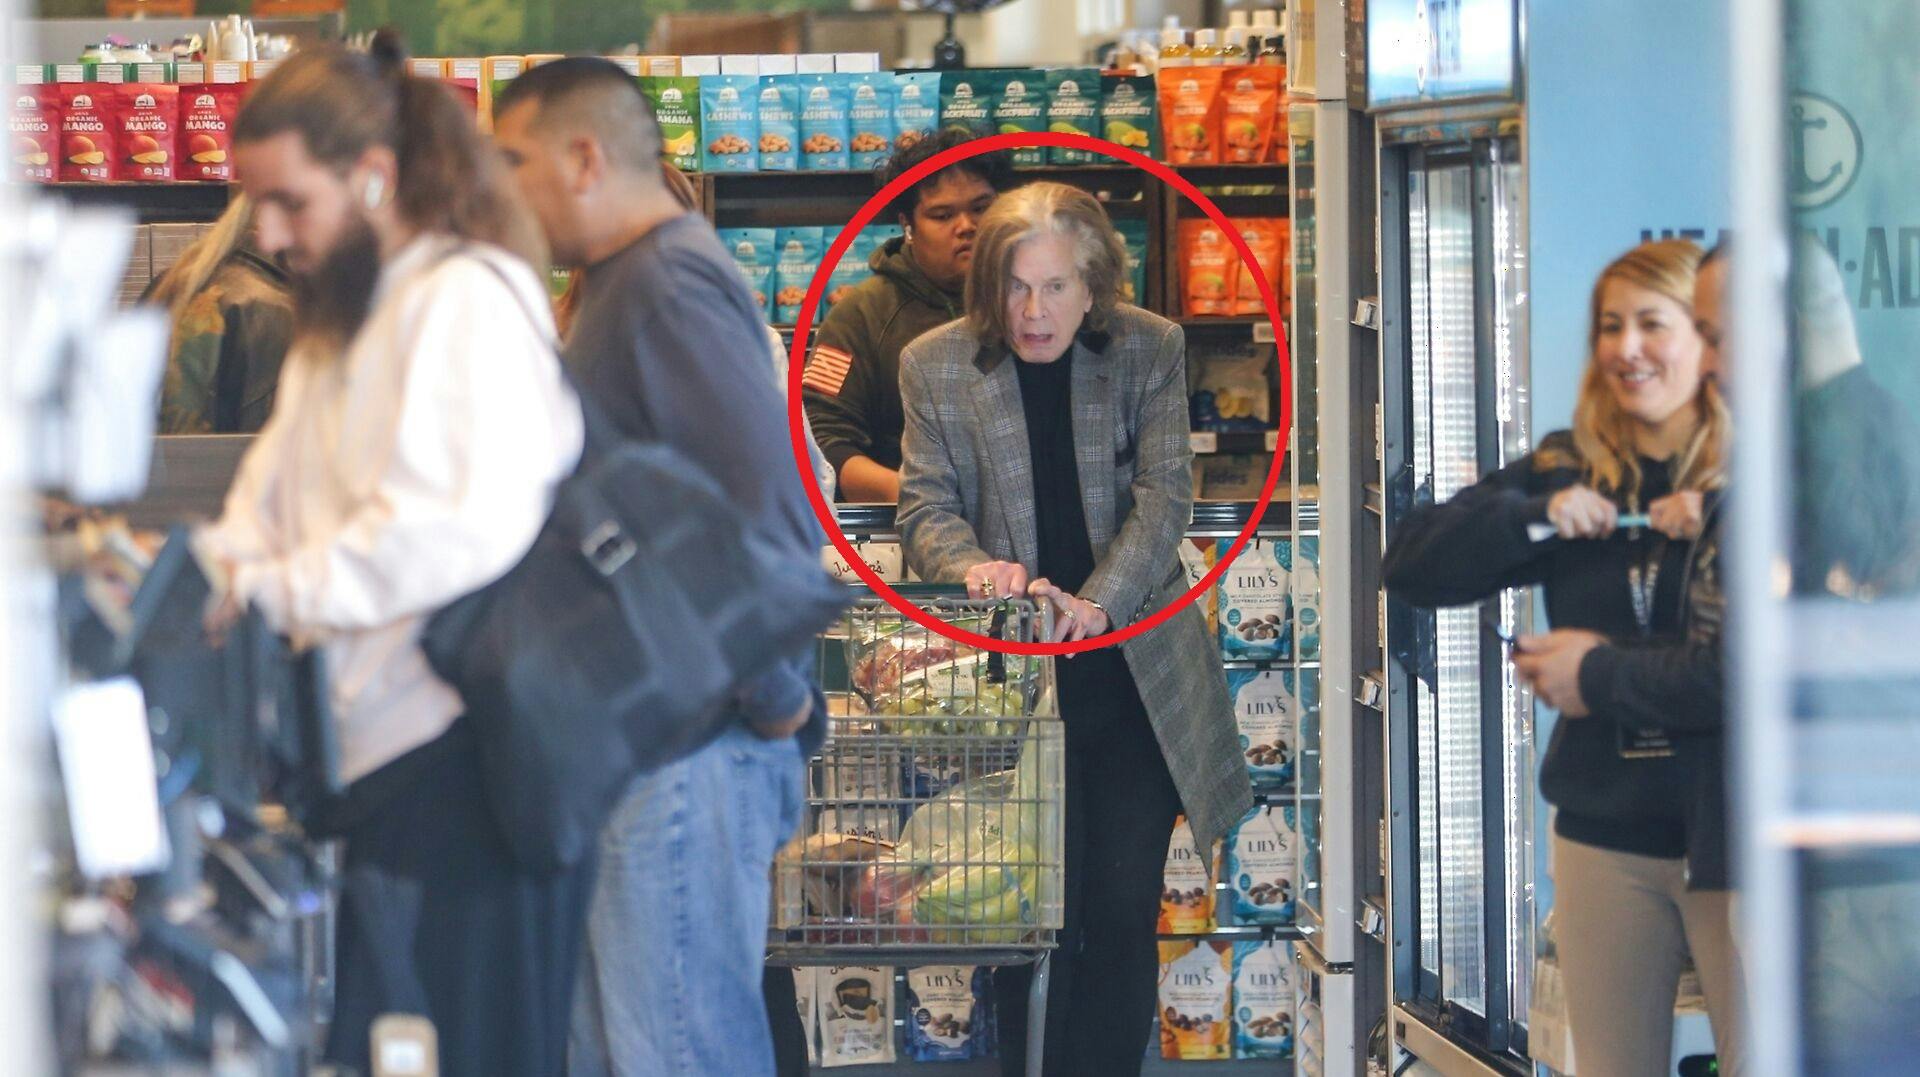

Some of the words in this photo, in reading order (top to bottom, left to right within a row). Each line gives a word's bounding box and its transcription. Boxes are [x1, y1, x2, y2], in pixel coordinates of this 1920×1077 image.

[656, 114, 693, 124] ANANA
[707, 111, 753, 121] CASHEWS
[62, 122, 104, 131] MANGO
[125, 121, 167, 131] MANGO
[185, 121, 226, 131] MANGO
[1238, 570, 1279, 588] LILY'S
[1247, 698, 1287, 715] LILY'S
[1248, 834, 1288, 852] LILY'S
[926, 969, 964, 987] LILY'S
[1174, 968, 1215, 985] LILY'S
[1250, 967, 1290, 985] LILY'S
